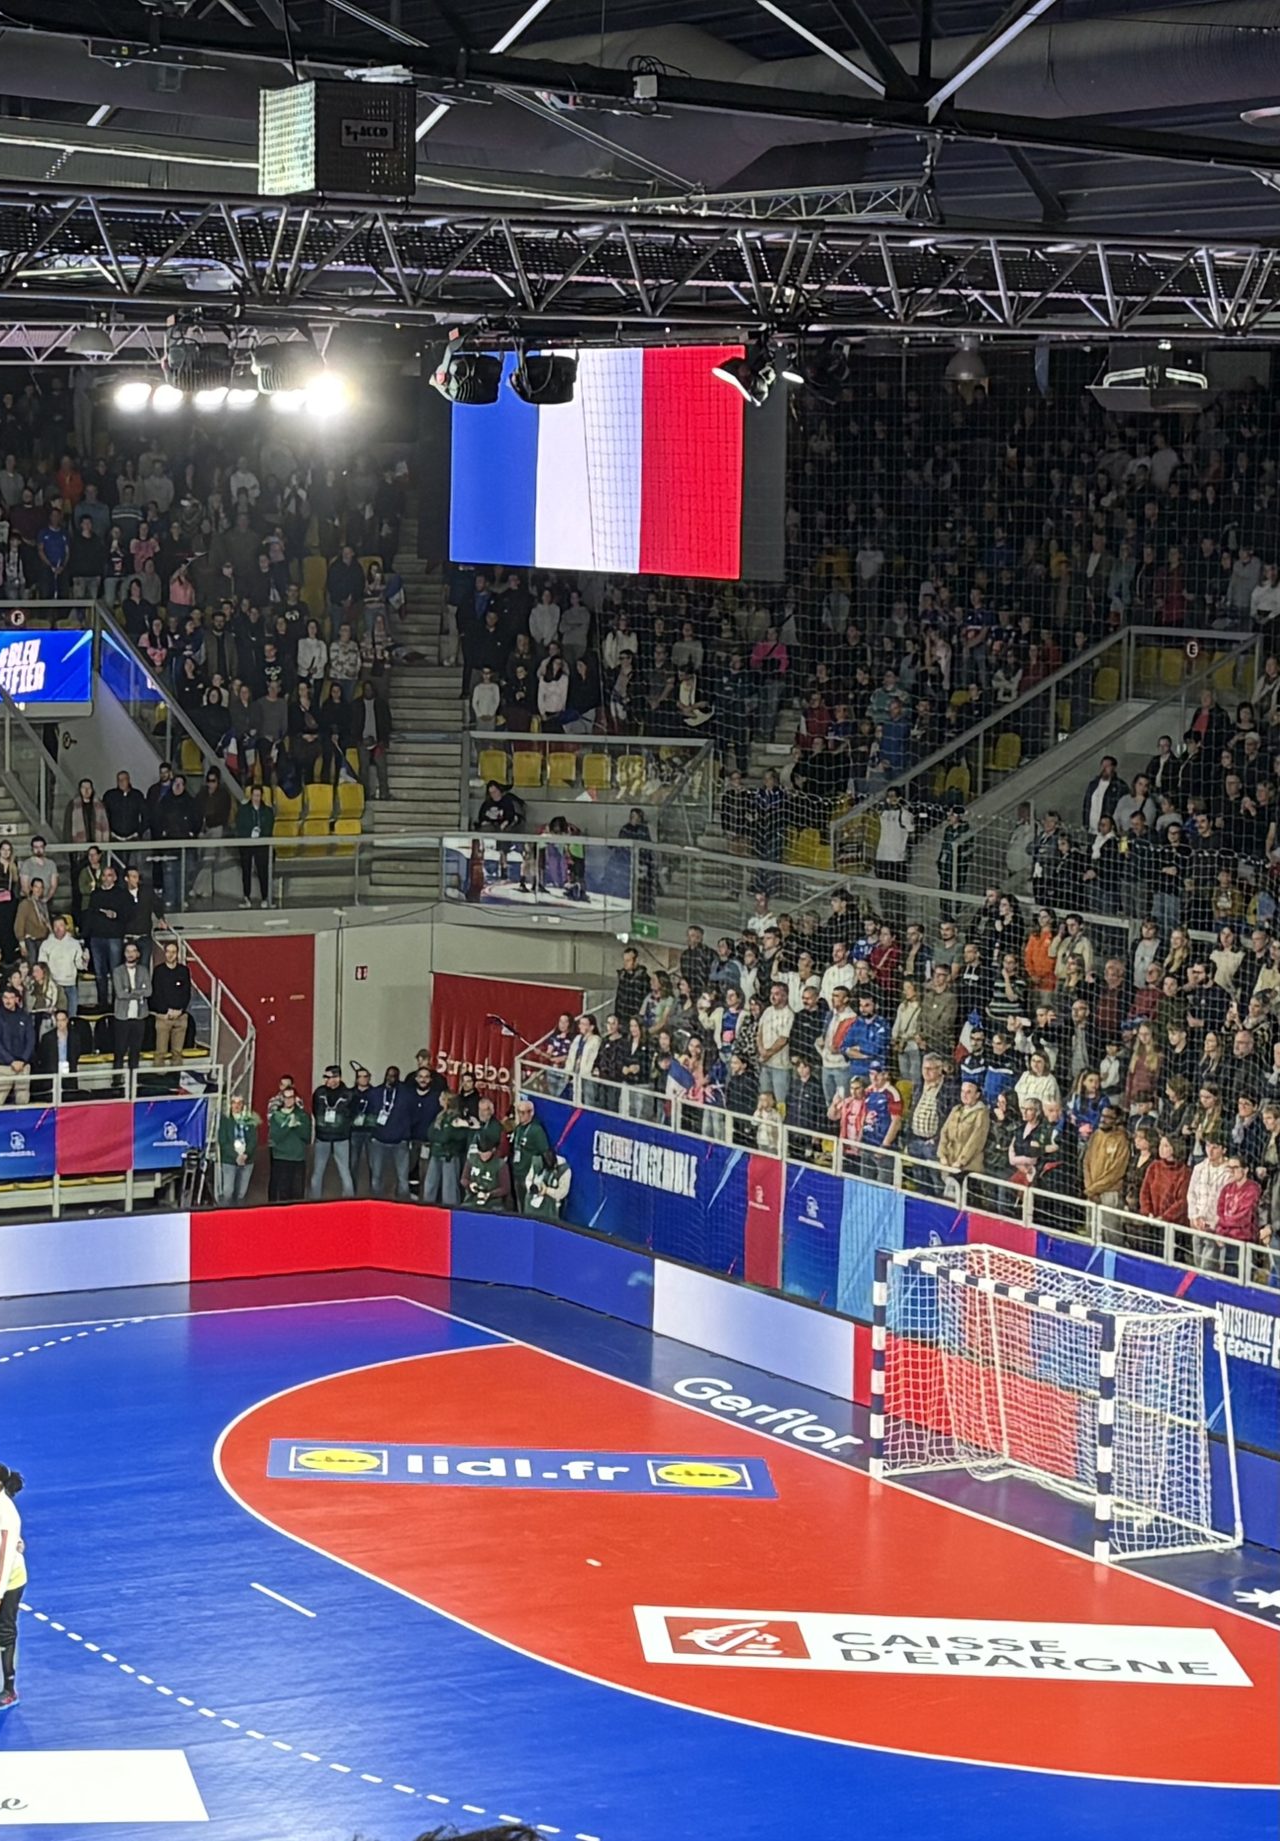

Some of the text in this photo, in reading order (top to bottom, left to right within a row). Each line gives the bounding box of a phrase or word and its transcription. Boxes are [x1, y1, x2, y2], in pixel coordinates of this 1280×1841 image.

[407, 1454, 630, 1481] lidl.fr
[832, 1632, 1067, 1654] CAISSE
[841, 1649, 1219, 1677] D'EPARGNE
